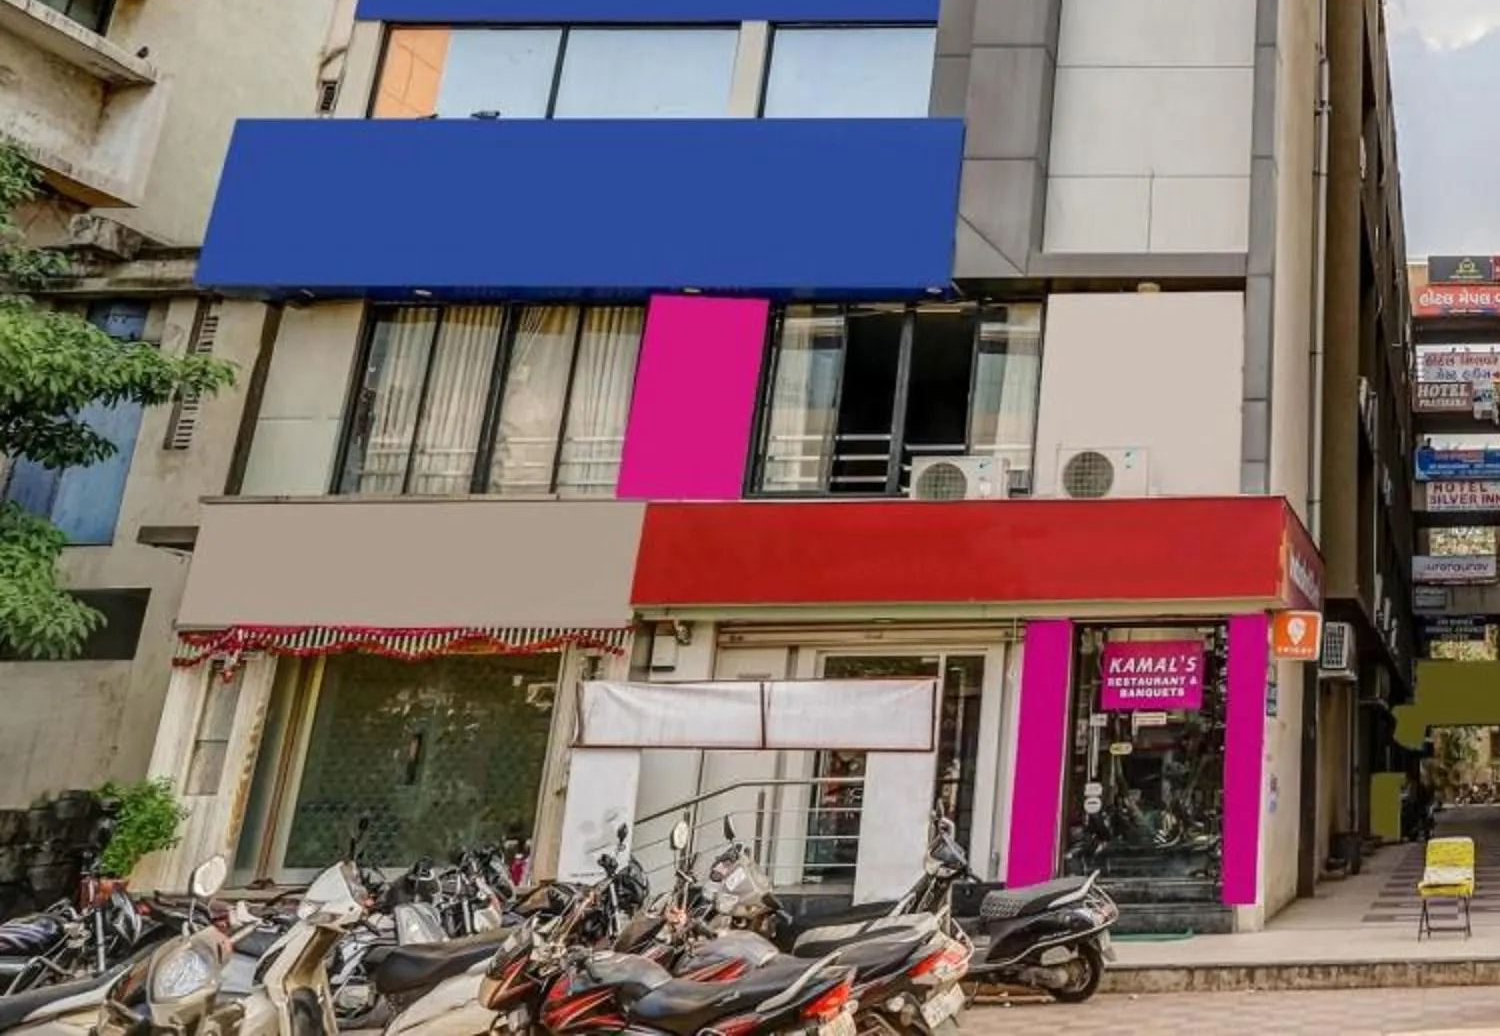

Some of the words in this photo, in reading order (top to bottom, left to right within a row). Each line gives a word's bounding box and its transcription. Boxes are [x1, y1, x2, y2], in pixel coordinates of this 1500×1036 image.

[1417, 384, 1469, 397] HOTEL
[1433, 482, 1488, 493] HOTEL
[1429, 493, 1478, 505] SILVER
[1109, 655, 1198, 673] KAMAL'S
[1107, 675, 1187, 687] RESTAURANT
[1119, 687, 1185, 699] BANQUETS
